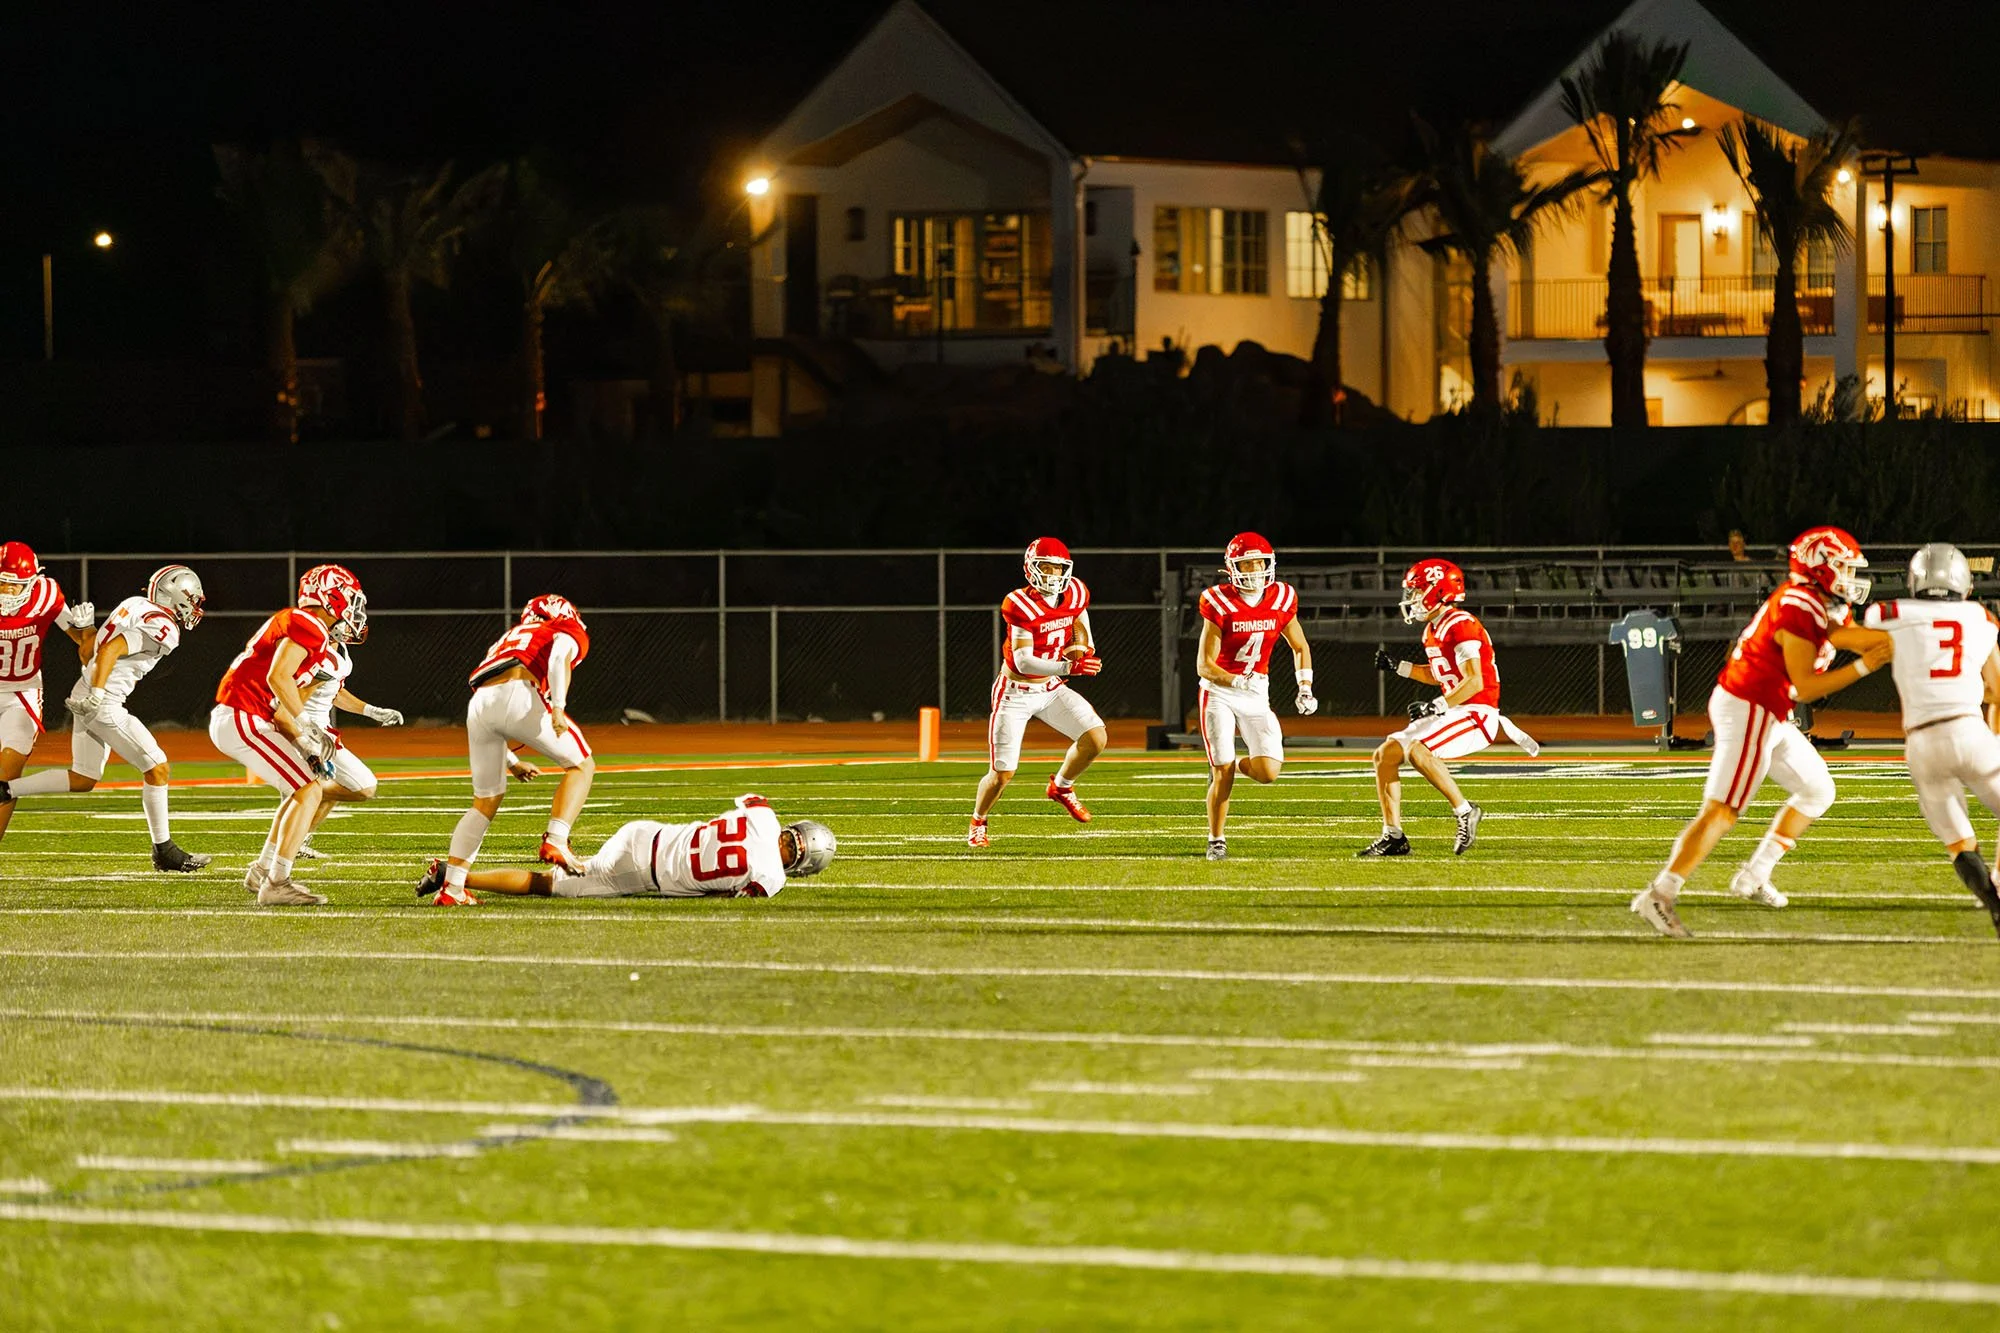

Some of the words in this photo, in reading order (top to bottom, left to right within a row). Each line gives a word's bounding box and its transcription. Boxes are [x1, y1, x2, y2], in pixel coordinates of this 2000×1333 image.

[1424, 565, 1444, 581] 26
[0, 625, 37, 640] RIMSON
[154, 625, 170, 641] 5
[1040, 616, 1073, 633] CRIMSON
[1232, 619, 1276, 632] CRIMSON
[1627, 627, 1657, 649] 99
[1234, 632, 1265, 674] 4
[1930, 620, 1962, 679] 3
[690, 816, 749, 882] 29
